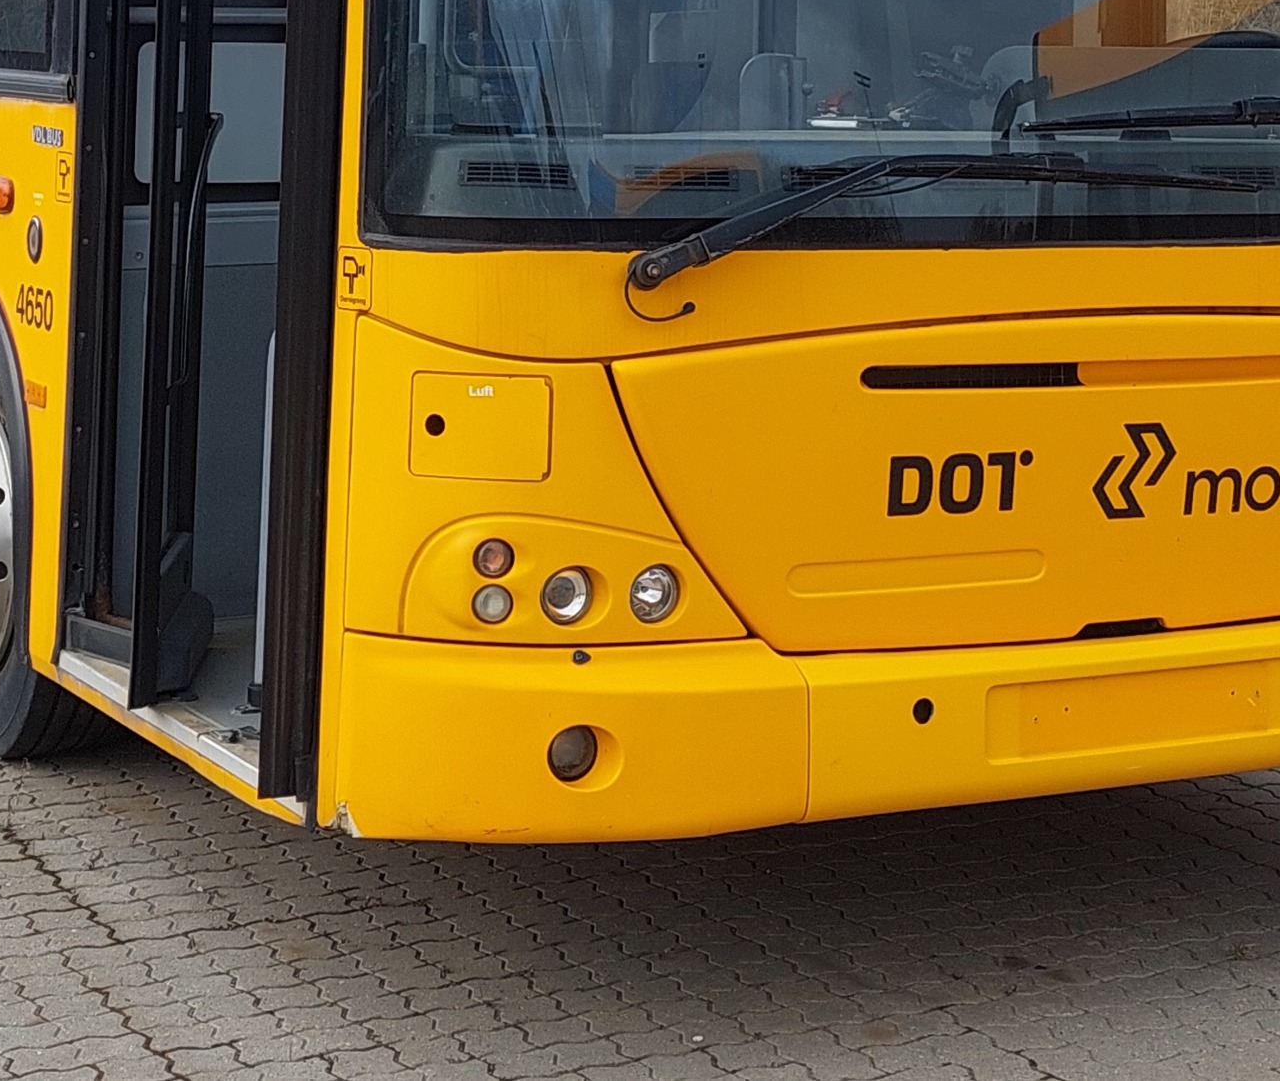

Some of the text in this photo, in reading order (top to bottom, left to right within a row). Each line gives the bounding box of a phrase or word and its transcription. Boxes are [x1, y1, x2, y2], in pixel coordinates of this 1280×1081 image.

[16, 283, 53, 332] 4650
[468, 385, 494, 397] Luft
[887, 450, 1033, 516] DOT
